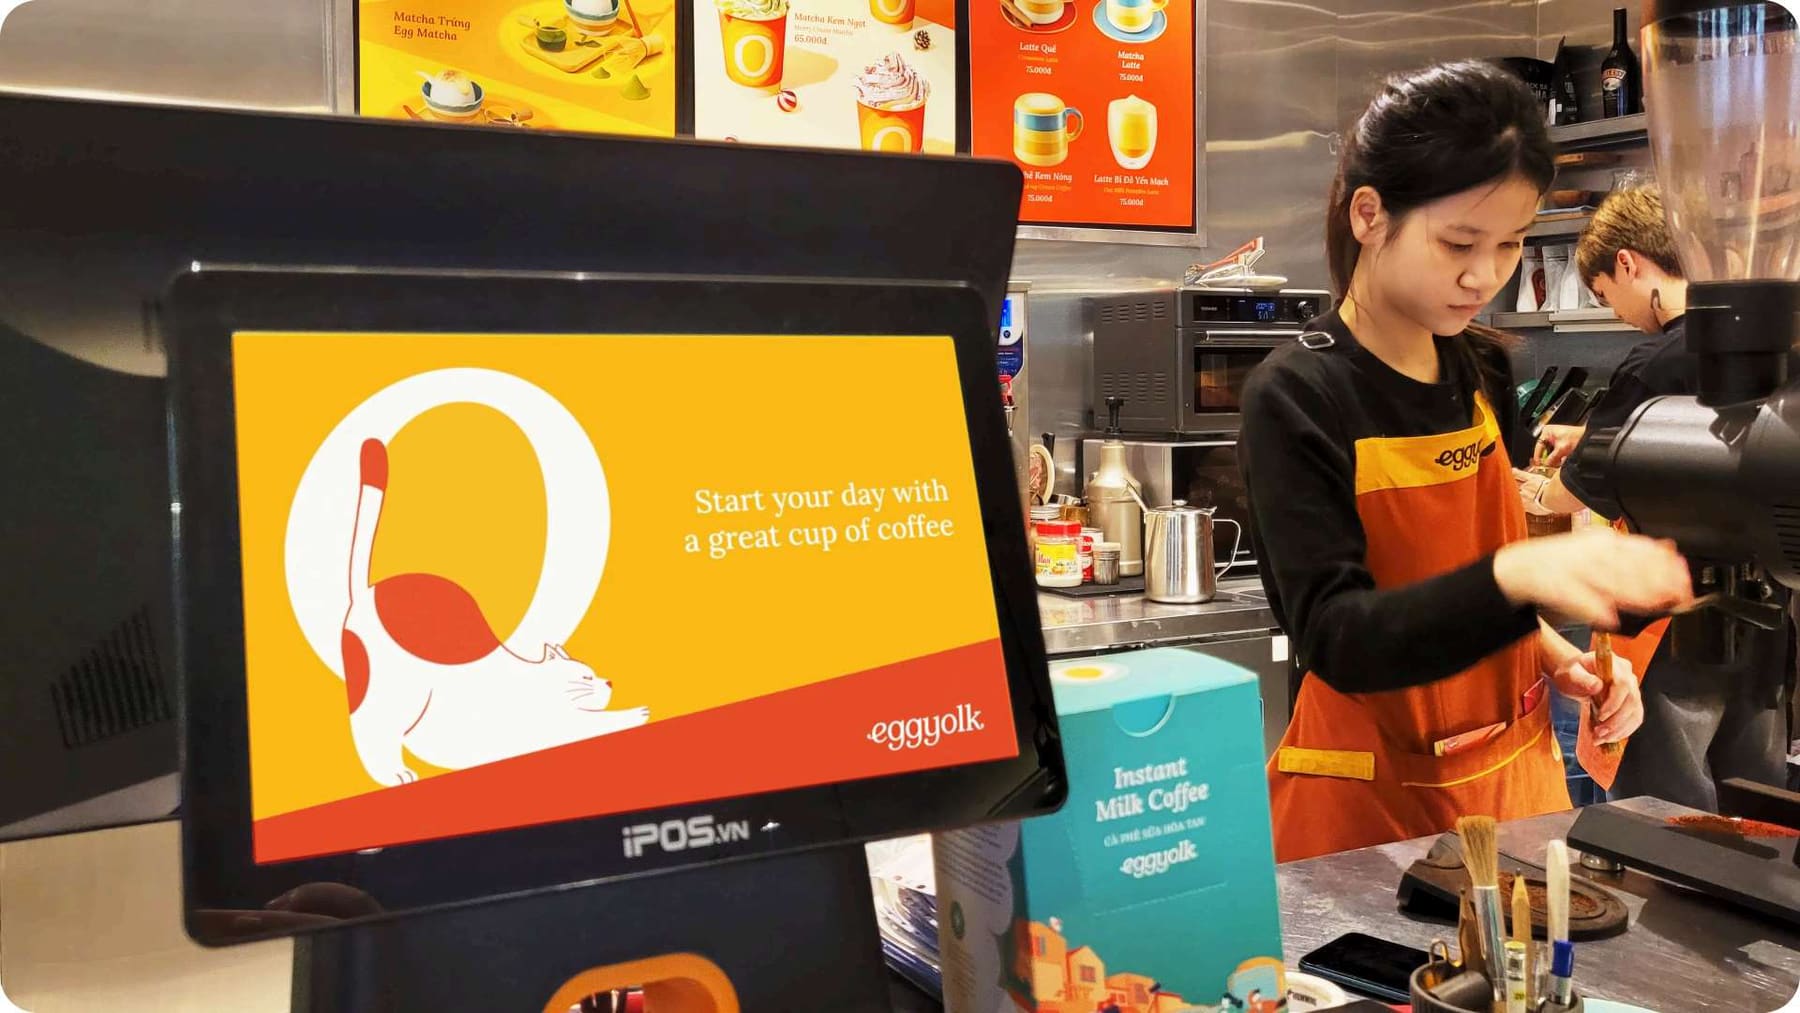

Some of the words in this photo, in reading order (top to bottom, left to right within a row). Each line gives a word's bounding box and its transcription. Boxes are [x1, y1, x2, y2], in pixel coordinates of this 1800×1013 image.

[394, 11, 435, 25] Matcha
[795, 13, 825, 24] Matcha
[827, 15, 845, 25] Kem
[394, 25, 414, 39] Egg
[417, 27, 457, 41] Matcha
[1019, 41, 1040, 52] Latte
[1117, 50, 1145, 61] Matcha
[1121, 60, 1141, 70] Latte
[1023, 170, 1034, 180] hê
[1035, 171, 1051, 181] Kem
[1094, 174, 1113, 184] Latte
[1435, 438, 1496, 471] eggy
[695, 488, 766, 514] Start
[773, 487, 834, 518] your
[841, 482, 885, 512] day
[893, 478, 950, 503] with
[684, 533, 701, 553] a
[708, 525, 781, 559] great
[788, 523, 837, 552] cup
[845, 516, 871, 542] of
[877, 513, 954, 541] coffee
[866, 704, 985, 751] eggyolk
[1113, 757, 1188, 789] Instant
[1095, 793, 1144, 822] Milk
[1147, 781, 1210, 813] Coffee
[1186, 816, 1206, 829] TAN
[621, 814, 750, 859] iPOS.VN
[1119, 839, 1199, 878] eggyolk
